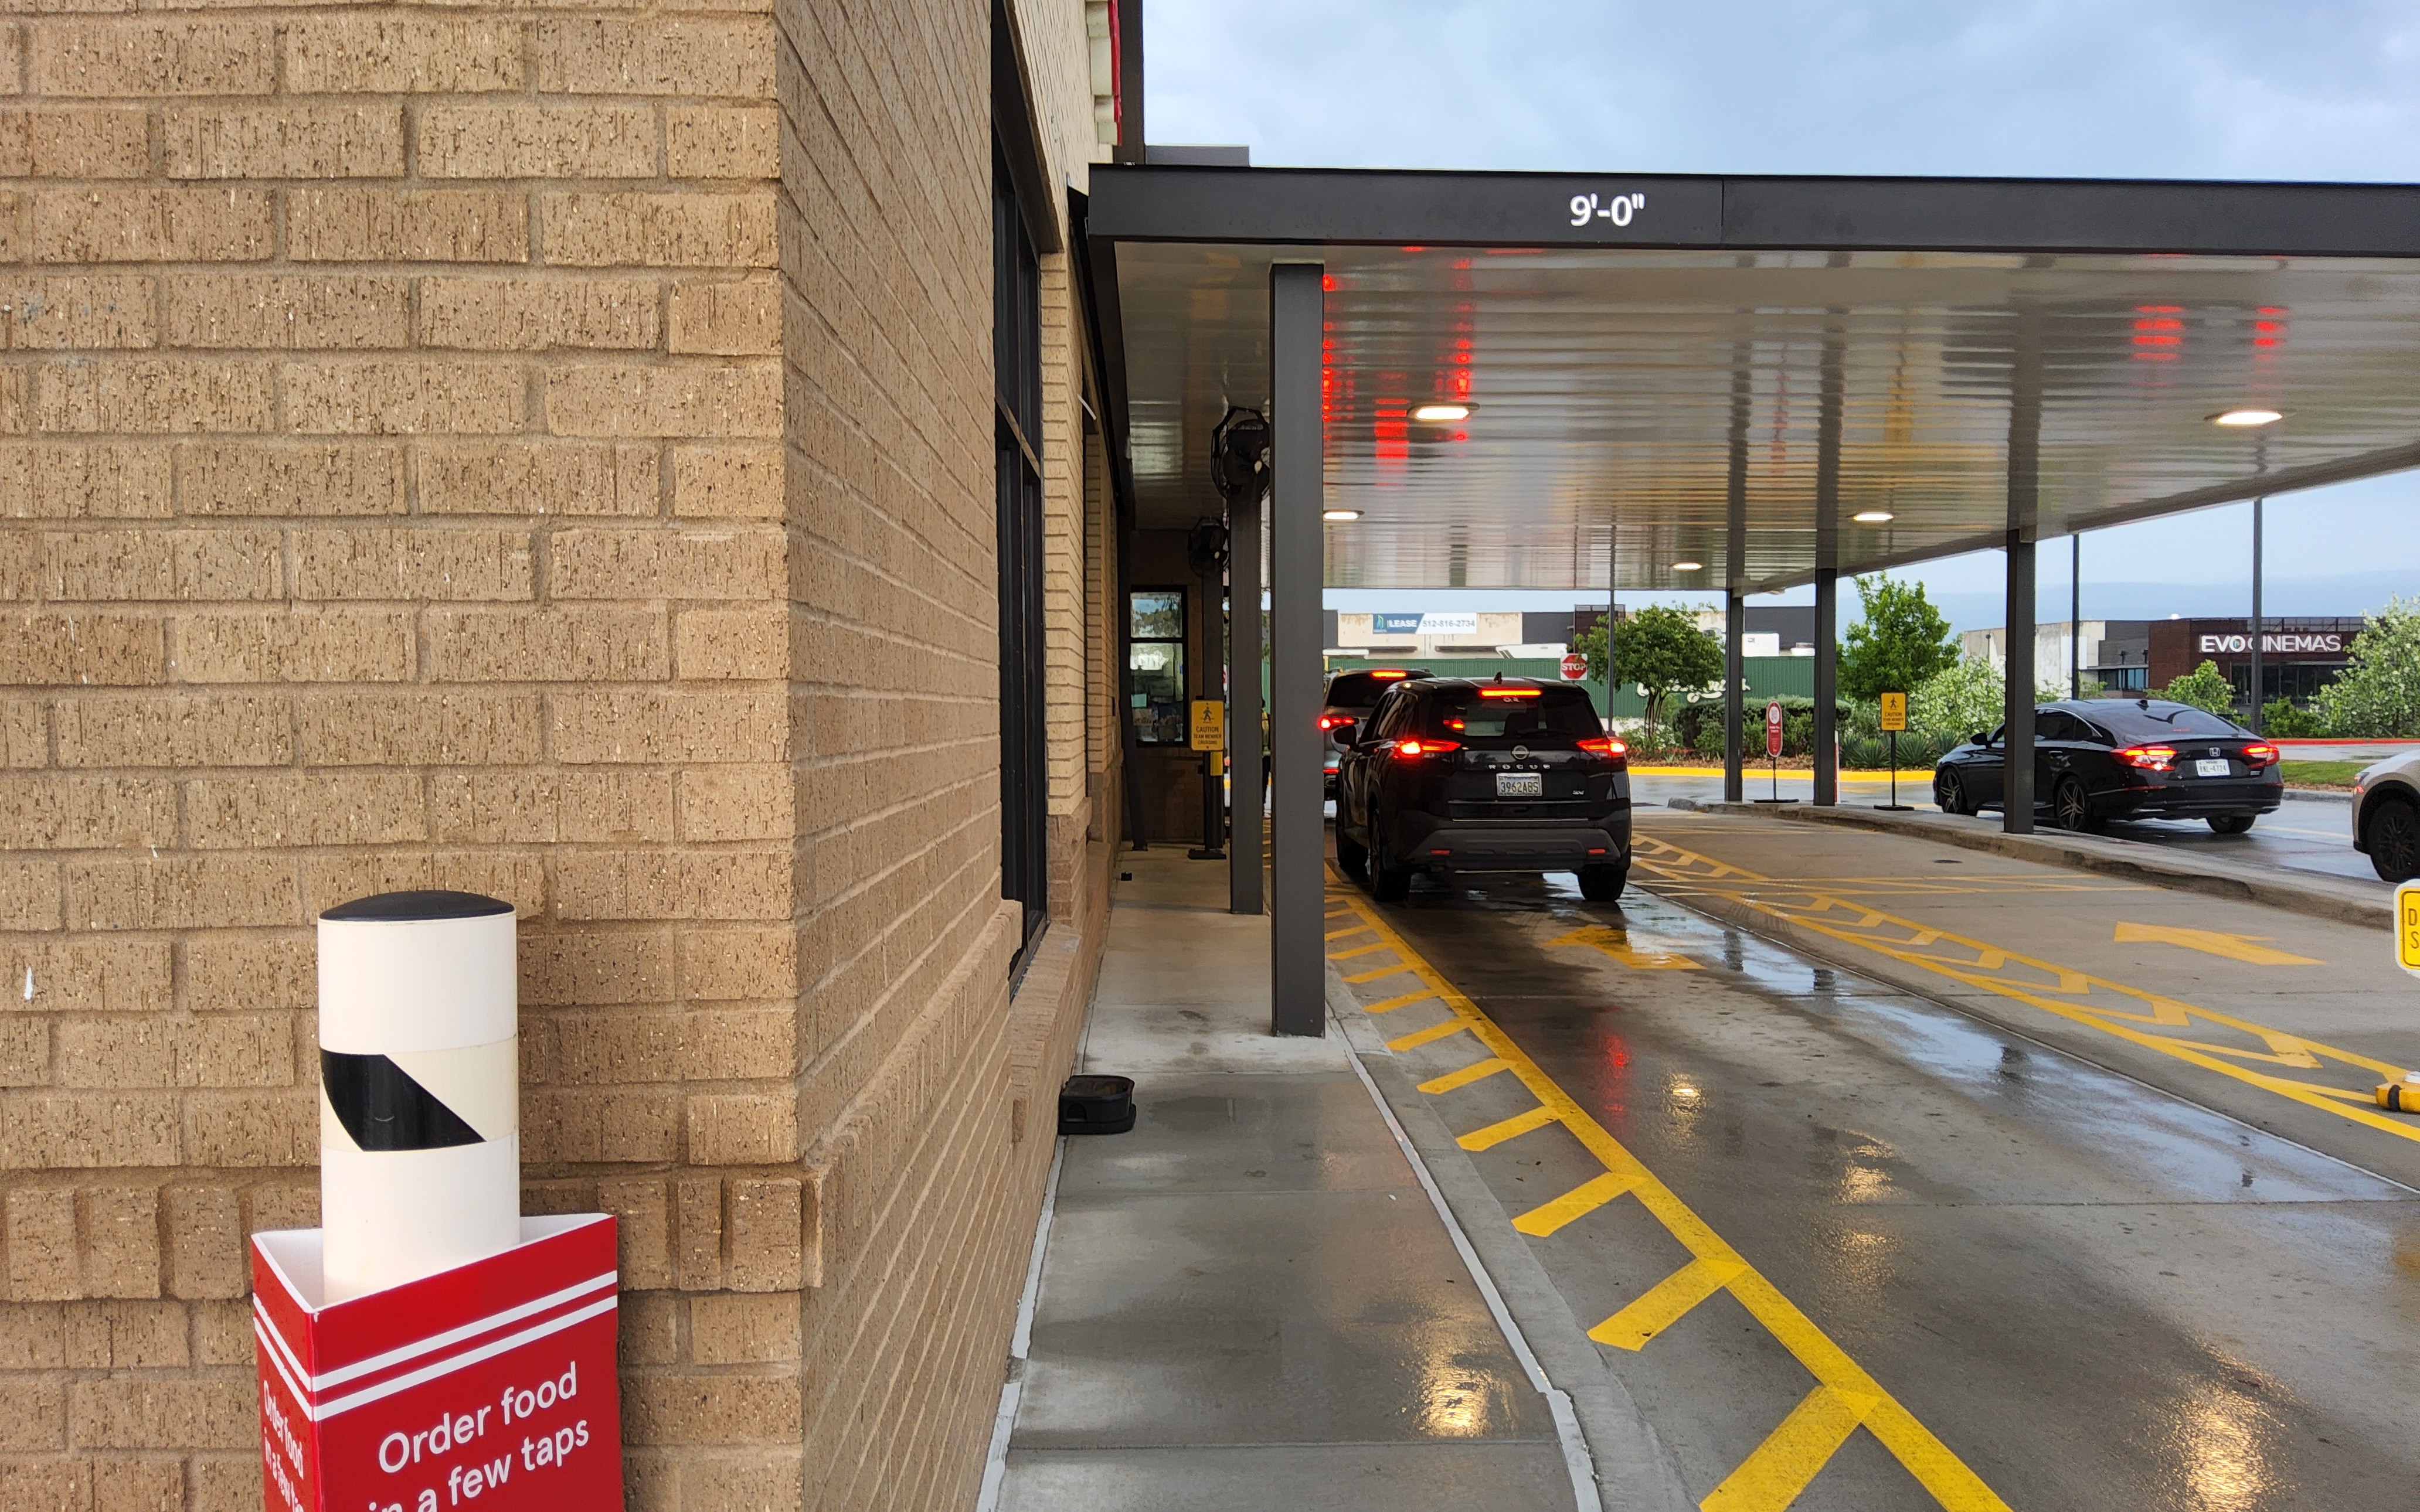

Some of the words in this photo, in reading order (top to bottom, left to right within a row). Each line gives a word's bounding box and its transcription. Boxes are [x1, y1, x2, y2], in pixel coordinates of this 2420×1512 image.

[1570, 192, 1645, 226] 9'-0"
[1388, 619, 1418, 628] LEASE
[2201, 635, 2246, 652] EVO
[1561, 663, 1586, 671] STOP
[264, 1380, 284, 1443] Order
[284, 1416, 304, 1480] food
[379, 1412, 491, 1473] Order
[501, 1360, 577, 1425] food
[448, 1454, 512, 1507] few
[521, 1419, 589, 1471] taps
